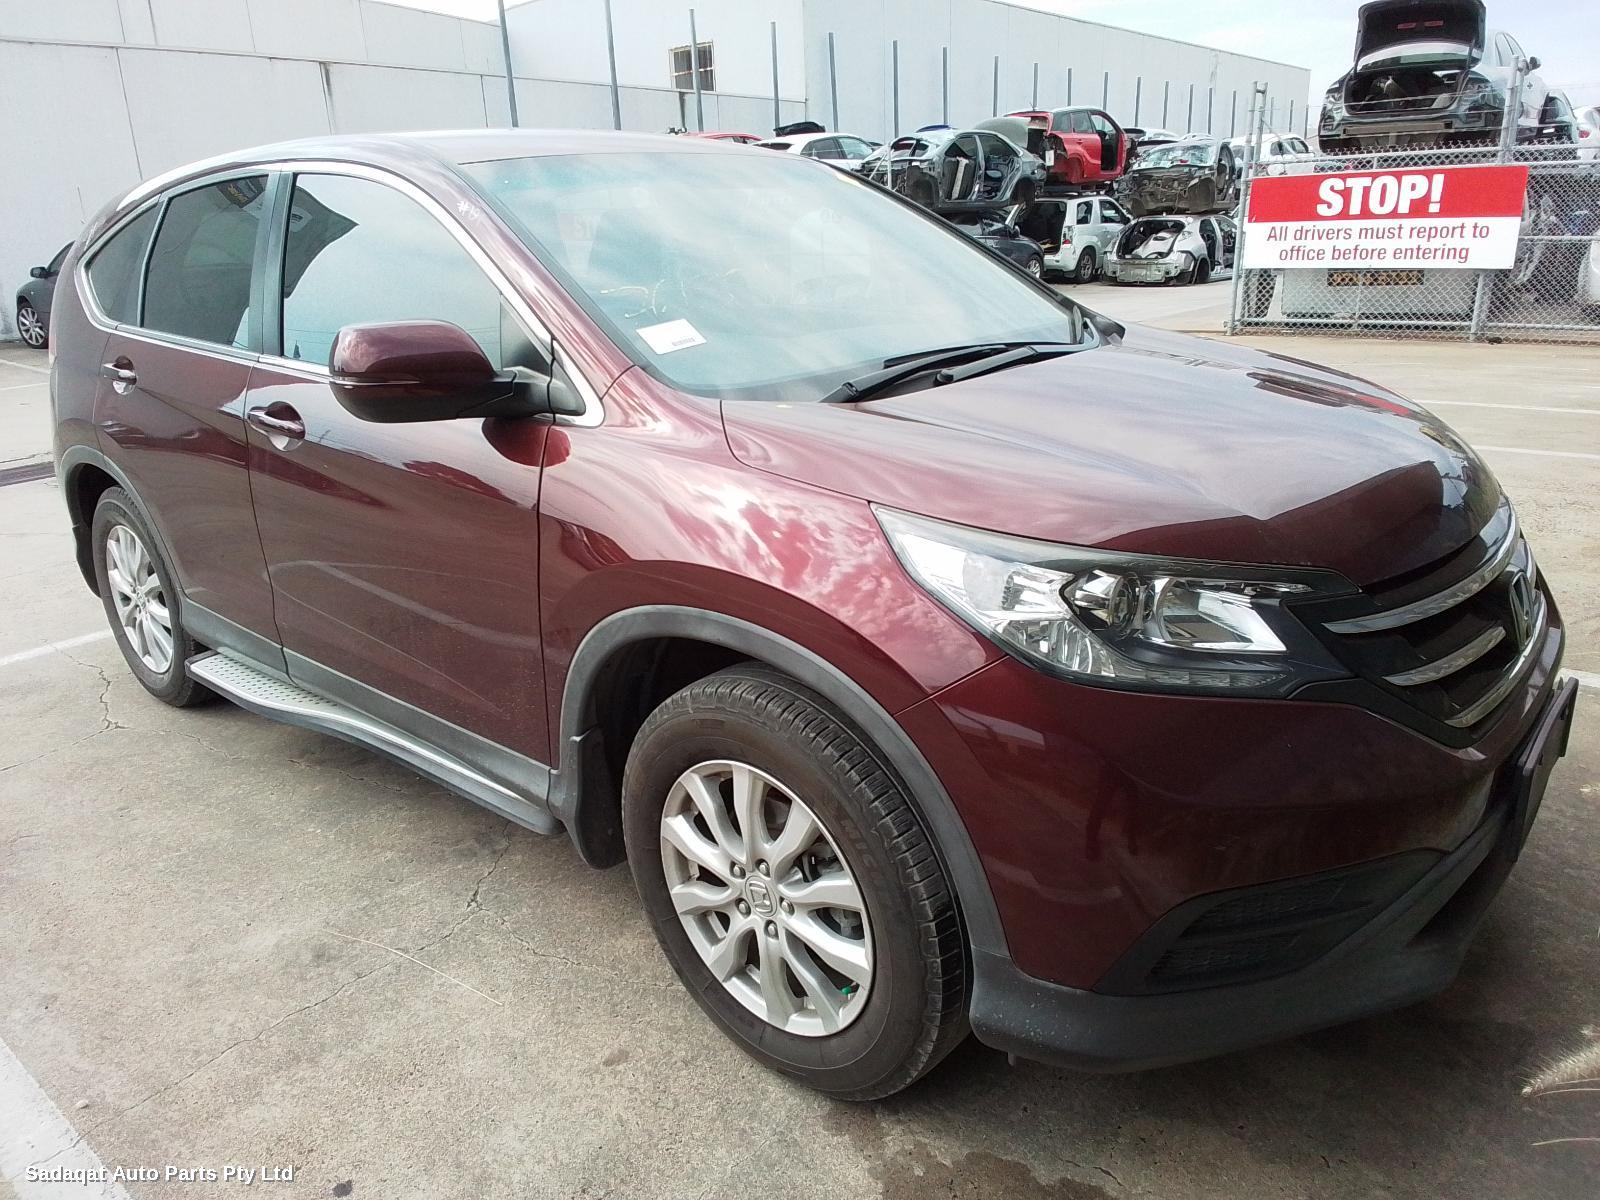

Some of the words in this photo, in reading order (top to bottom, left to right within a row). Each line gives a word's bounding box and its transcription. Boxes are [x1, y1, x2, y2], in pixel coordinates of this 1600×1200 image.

[1316, 174, 1445, 216] STOP!
[1267, 226, 1288, 241] All
[1293, 225, 1353, 241] drivers
[1358, 224, 1404, 240] must
[1408, 223, 1466, 242] report
[1472, 222, 1490, 239] to
[1279, 245, 1326, 261] office
[1331, 244, 1387, 261] before
[1393, 243, 1470, 263] entering
